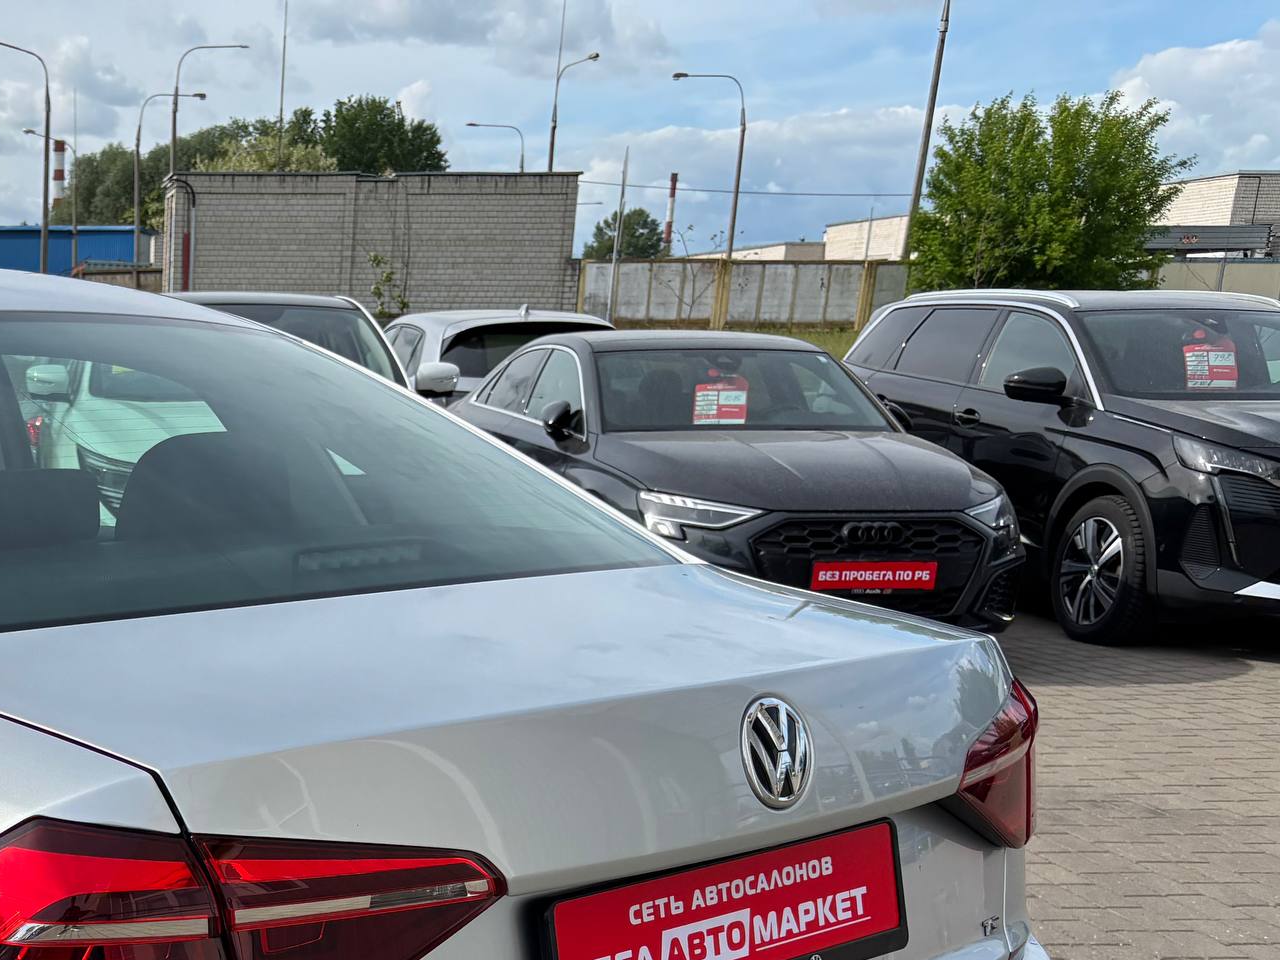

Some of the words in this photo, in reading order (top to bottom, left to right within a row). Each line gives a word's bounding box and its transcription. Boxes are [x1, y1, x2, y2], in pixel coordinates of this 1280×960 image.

[818, 570, 839, 581] БЕЗ
[841, 570, 893, 581] ПРОБЕГА
[895, 570, 912, 581] ПО
[914, 570, 930, 581] РБ
[629, 896, 684, 926] СЕТЬ
[691, 856, 833, 911] АВТОСАЛОНОВ
